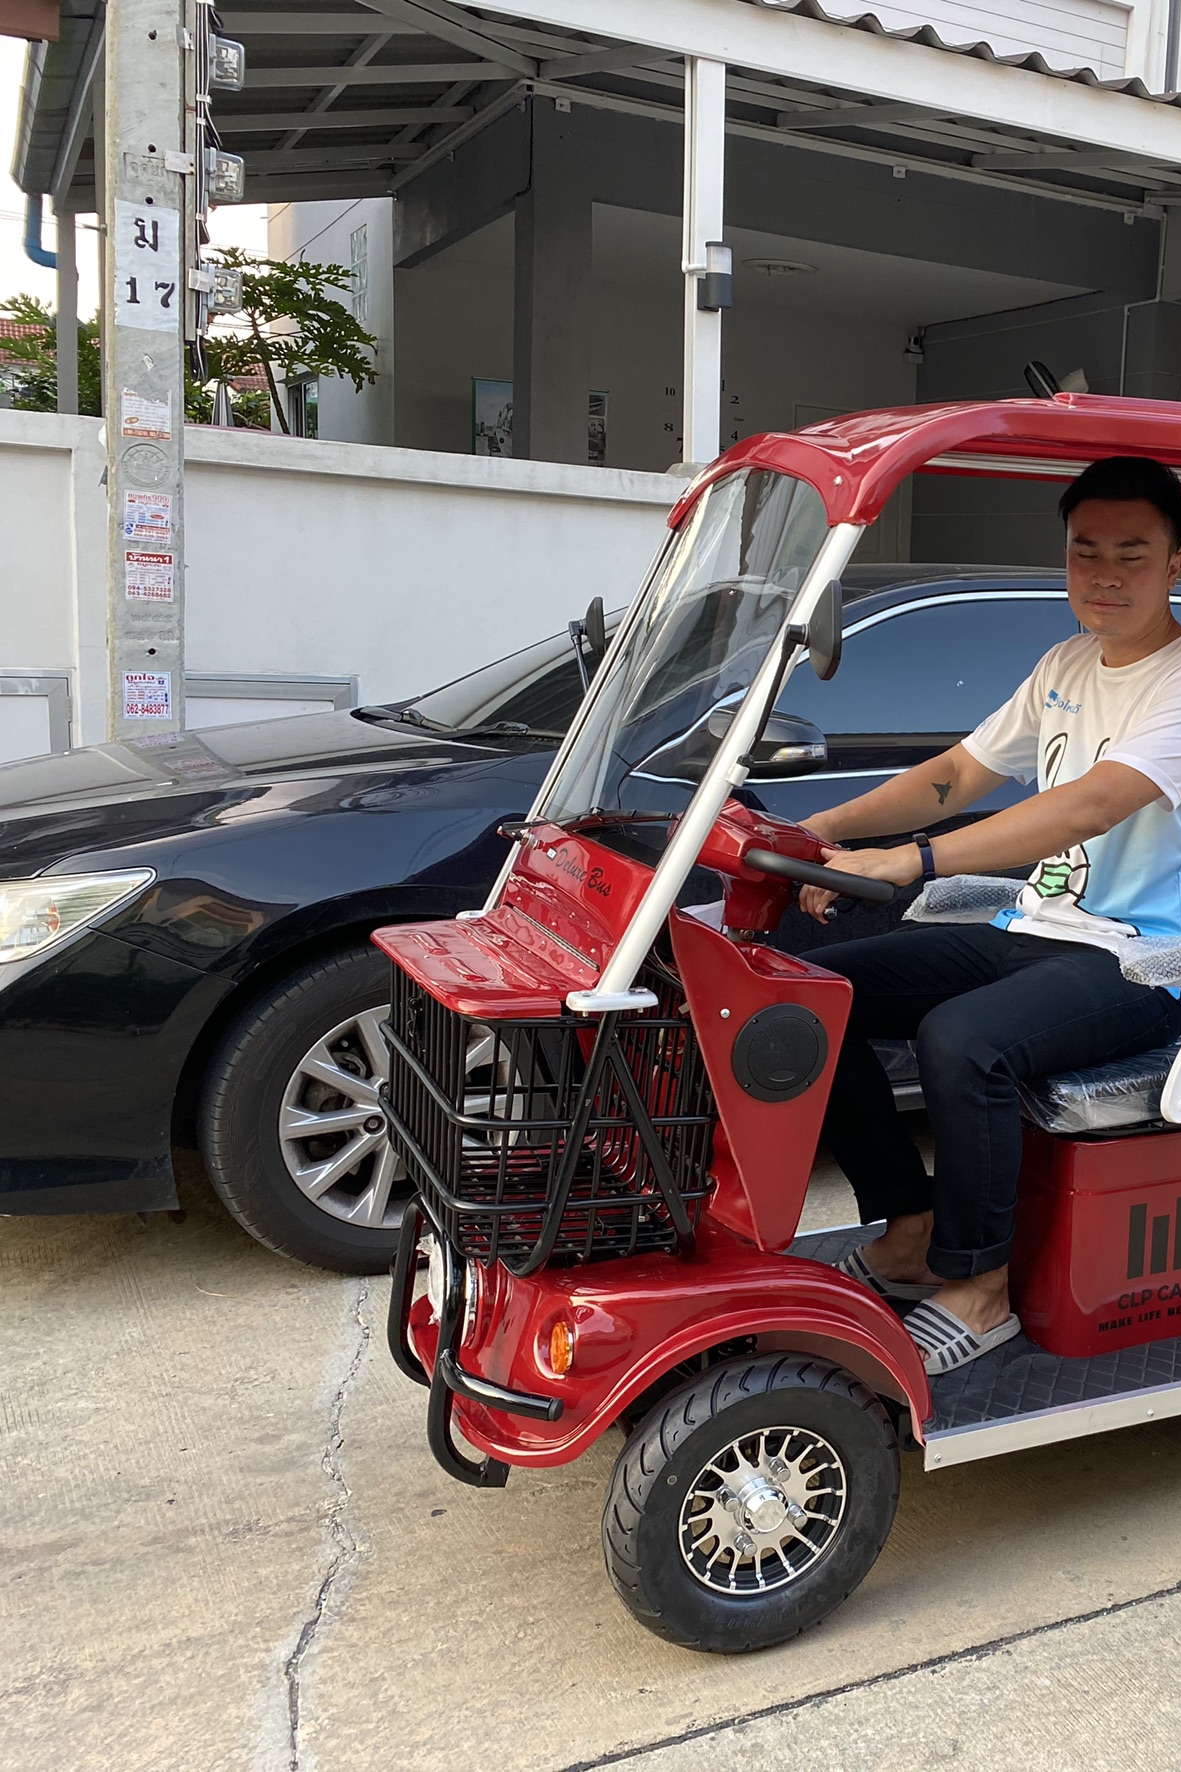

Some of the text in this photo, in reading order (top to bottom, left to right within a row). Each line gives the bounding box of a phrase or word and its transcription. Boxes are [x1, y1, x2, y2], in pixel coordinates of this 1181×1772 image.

[665, 387, 676, 396] 10
[730, 395, 740, 405] 2
[664, 422, 674, 432] 8
[731, 430, 739, 441] 4
[126, 703, 169, 715] 062-8483877
[555, 848, 612, 897] Deluxe Bus
[1117, 1289, 1153, 1311] CLP
[1098, 1316, 1133, 1333] MAKE
[1138, 1309, 1162, 1323] LIFE
